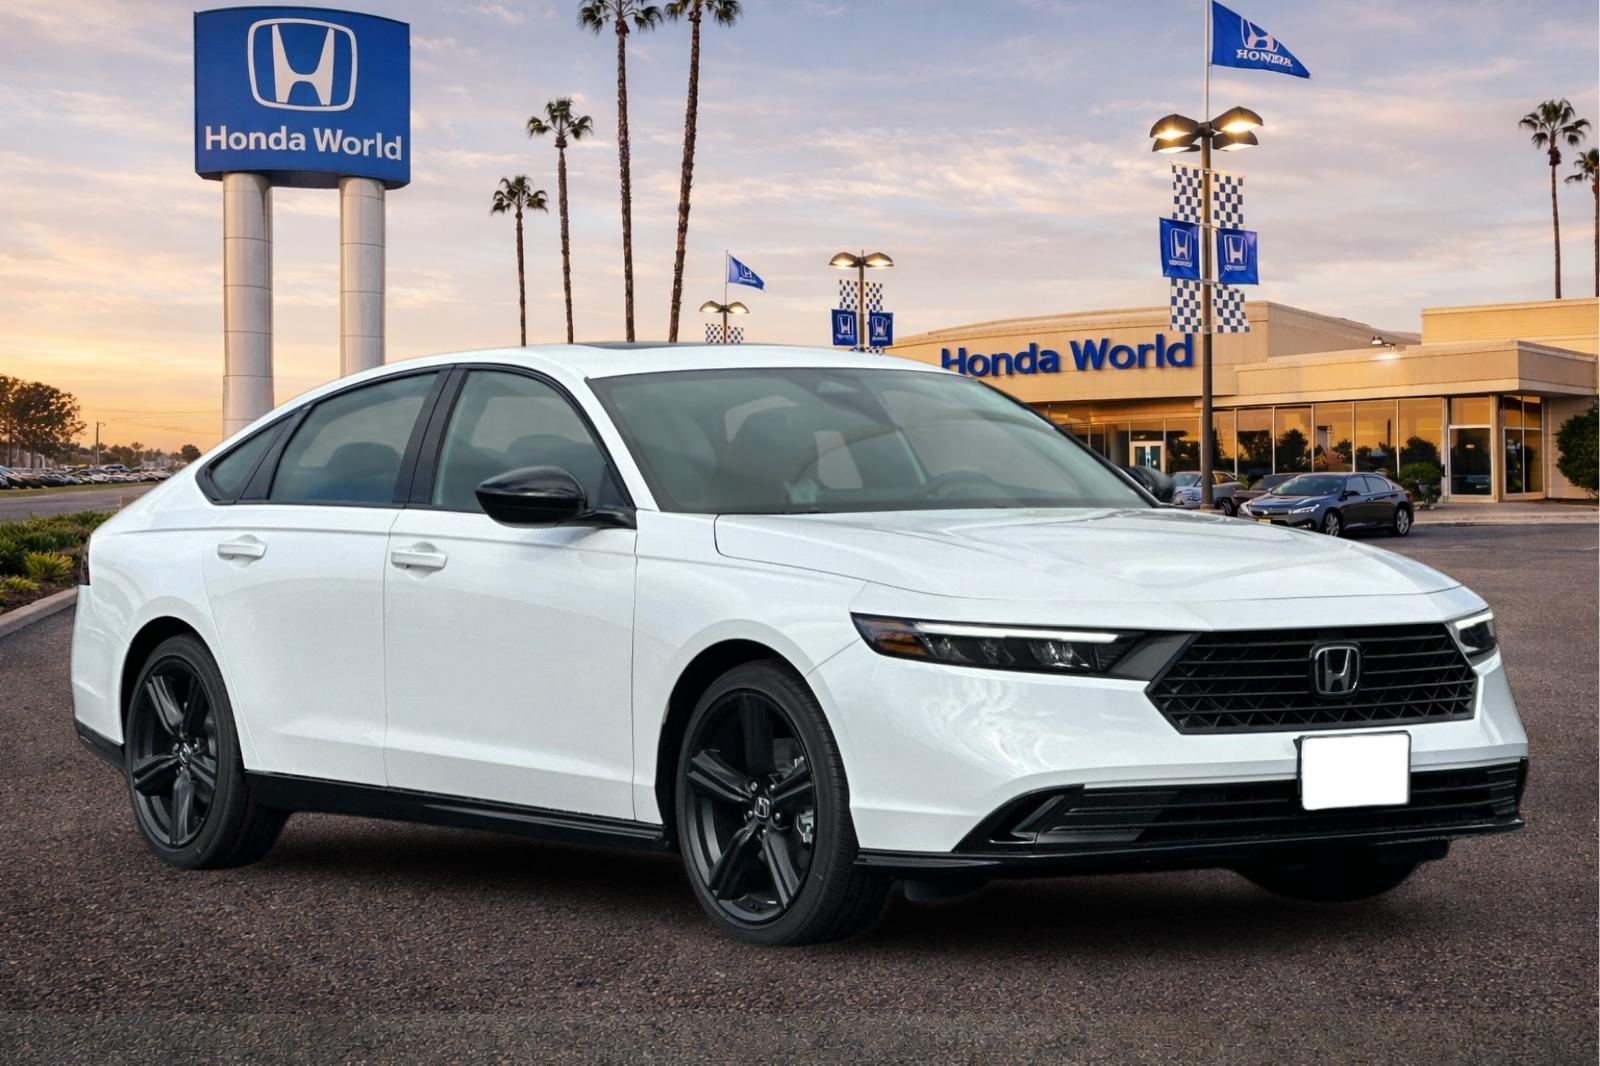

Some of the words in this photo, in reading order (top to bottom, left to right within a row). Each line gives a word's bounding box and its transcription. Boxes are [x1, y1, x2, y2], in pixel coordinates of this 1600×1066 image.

[205, 125, 306, 151] Honda
[313, 127, 402, 160] World
[941, 342, 1061, 377] Honda
[1069, 333, 1194, 371] World
